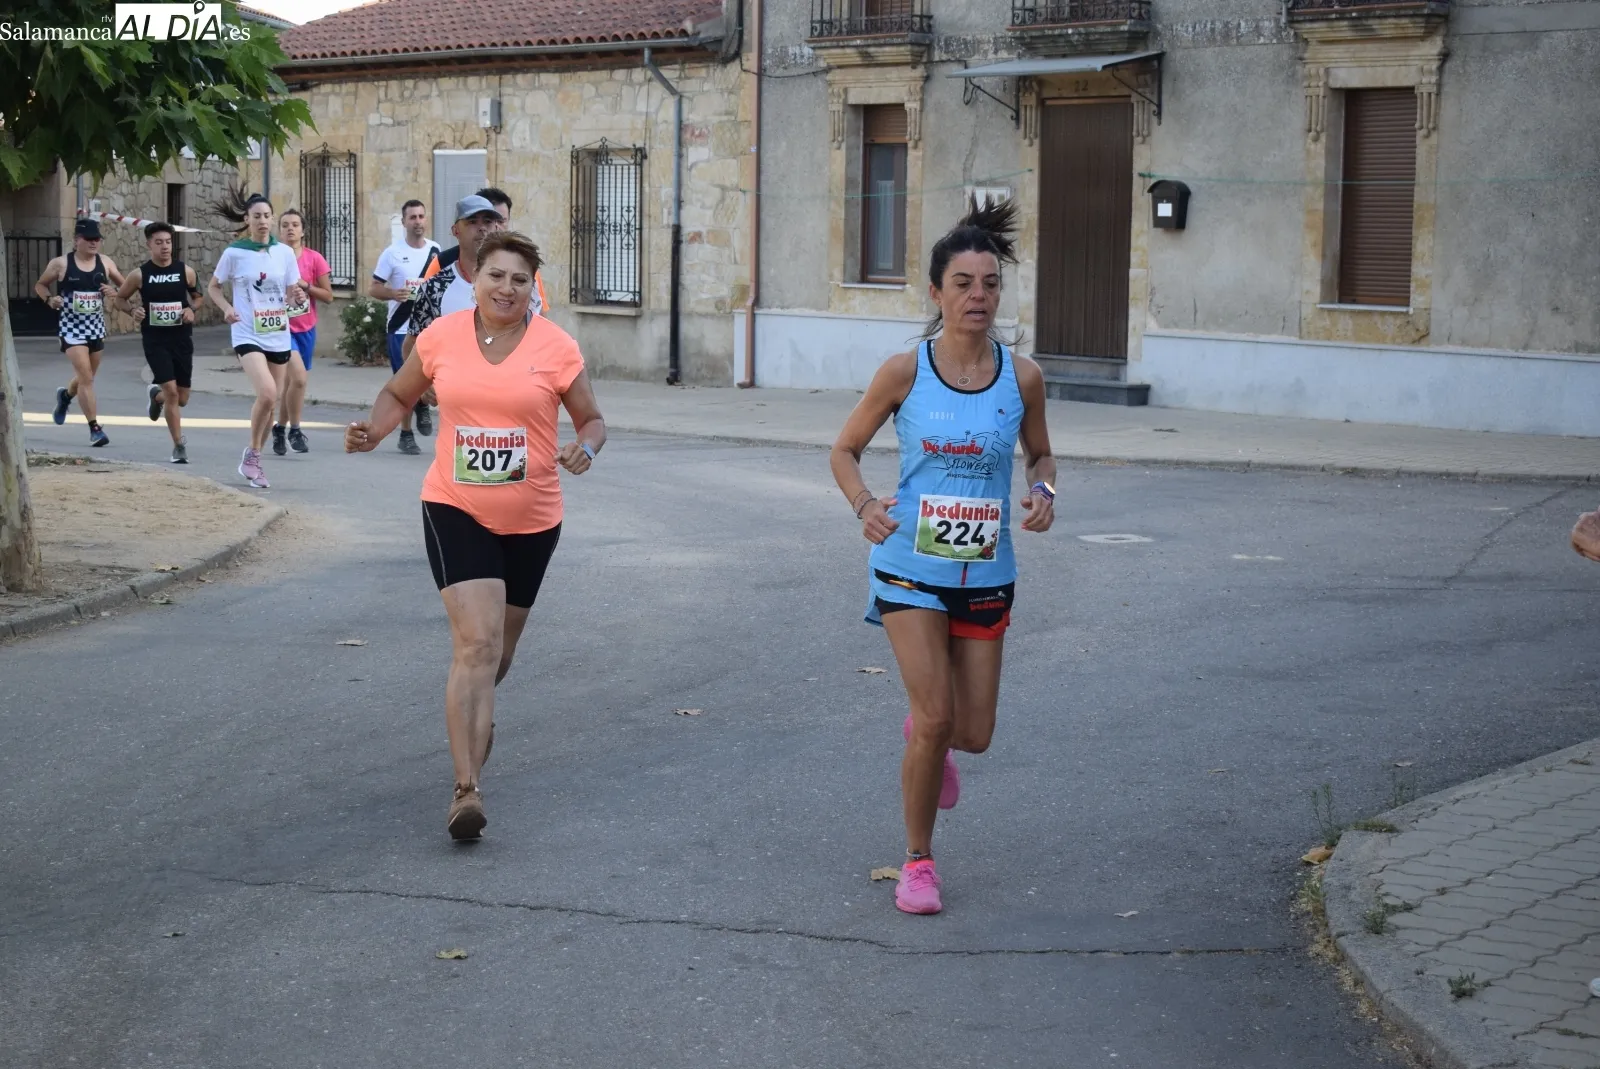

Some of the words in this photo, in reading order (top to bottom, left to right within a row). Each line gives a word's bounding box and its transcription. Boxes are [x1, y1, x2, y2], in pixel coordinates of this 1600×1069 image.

[148, 273, 181, 284] NIKE
[79, 299, 97, 308] 213
[151, 304, 182, 312] bedunia
[156, 311, 176, 320] 230
[254, 308, 286, 317] bedunia
[261, 316, 281, 328] 208
[456, 429, 526, 449] bedunia
[466, 448, 513, 472] 207
[951, 457, 993, 473] FLOWERS
[920, 500, 1000, 521] bedunia
[934, 520, 985, 547] 224
